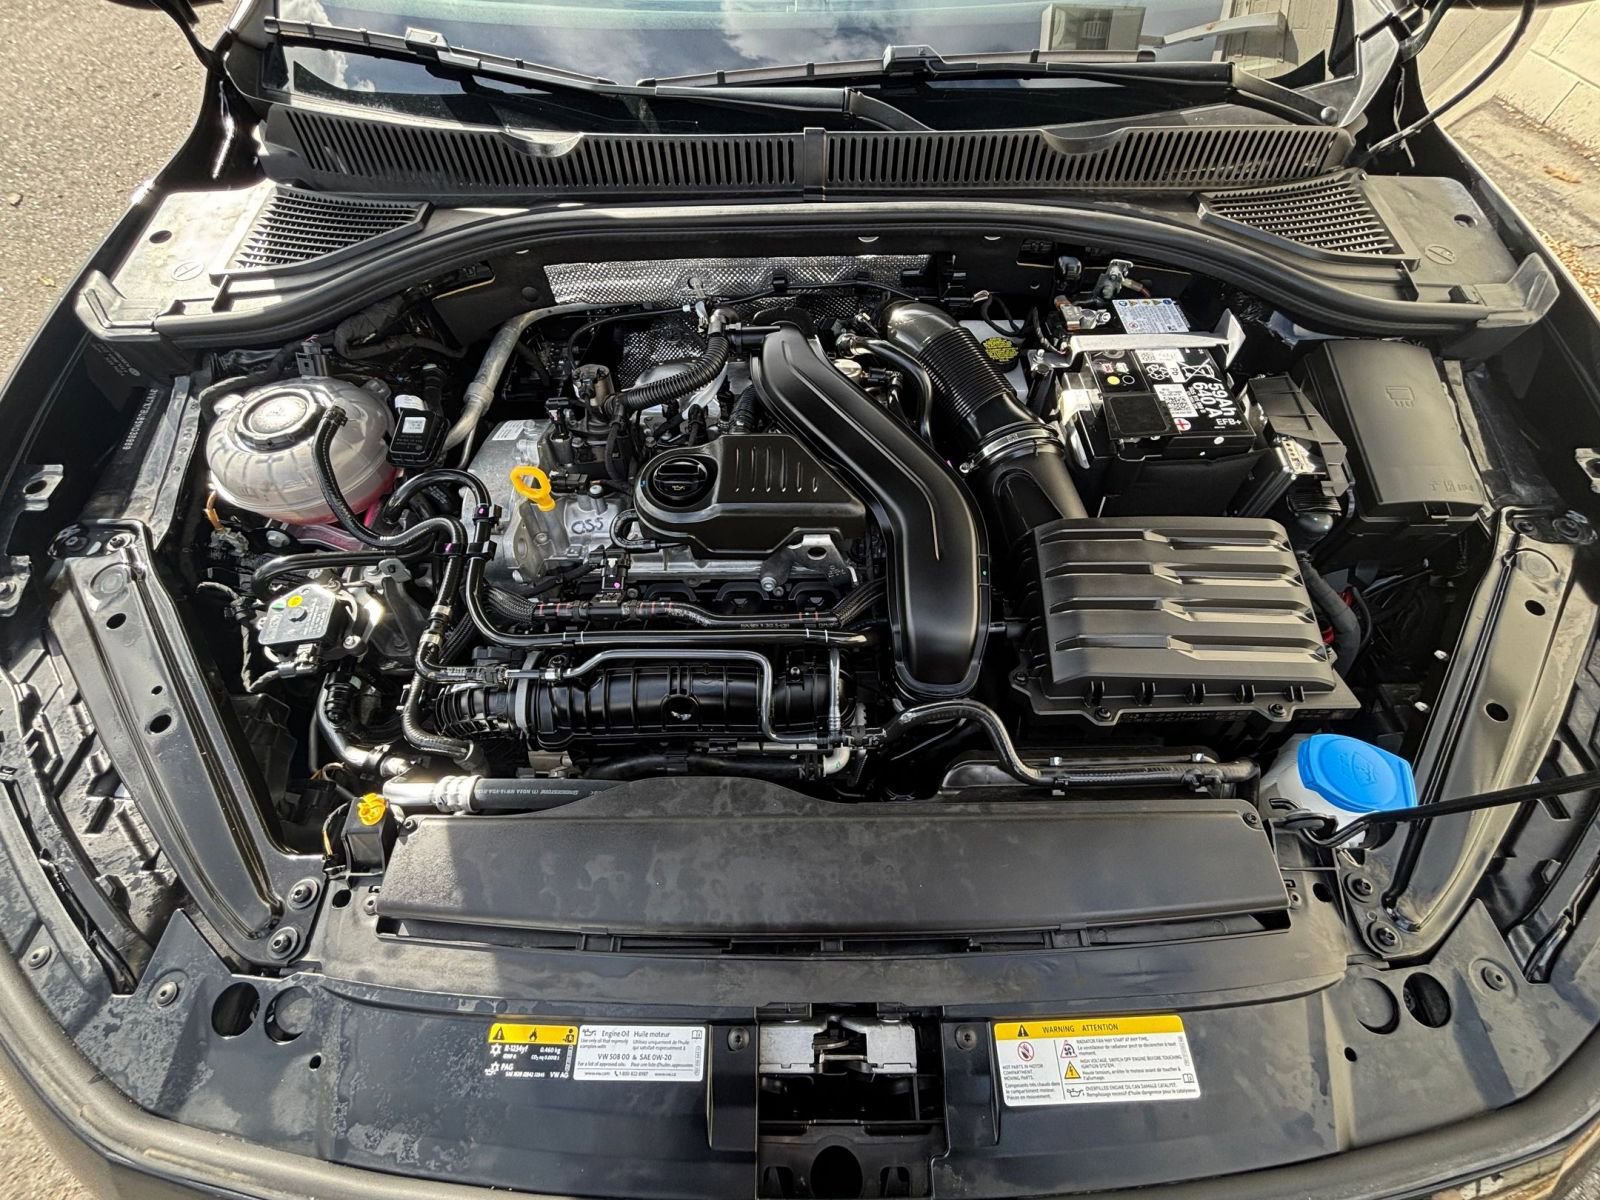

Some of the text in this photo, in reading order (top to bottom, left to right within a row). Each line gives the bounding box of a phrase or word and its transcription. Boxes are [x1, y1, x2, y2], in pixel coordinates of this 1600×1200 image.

[1192, 382, 1215, 406] 640
[1207, 407, 1222, 418] A
[1207, 382, 1237, 416] 59Ah
[1216, 418, 1242, 426] EFB+
[601, 1030, 621, 1038] Engine
[1042, 1023, 1118, 1034] WARNING ATTENTION
